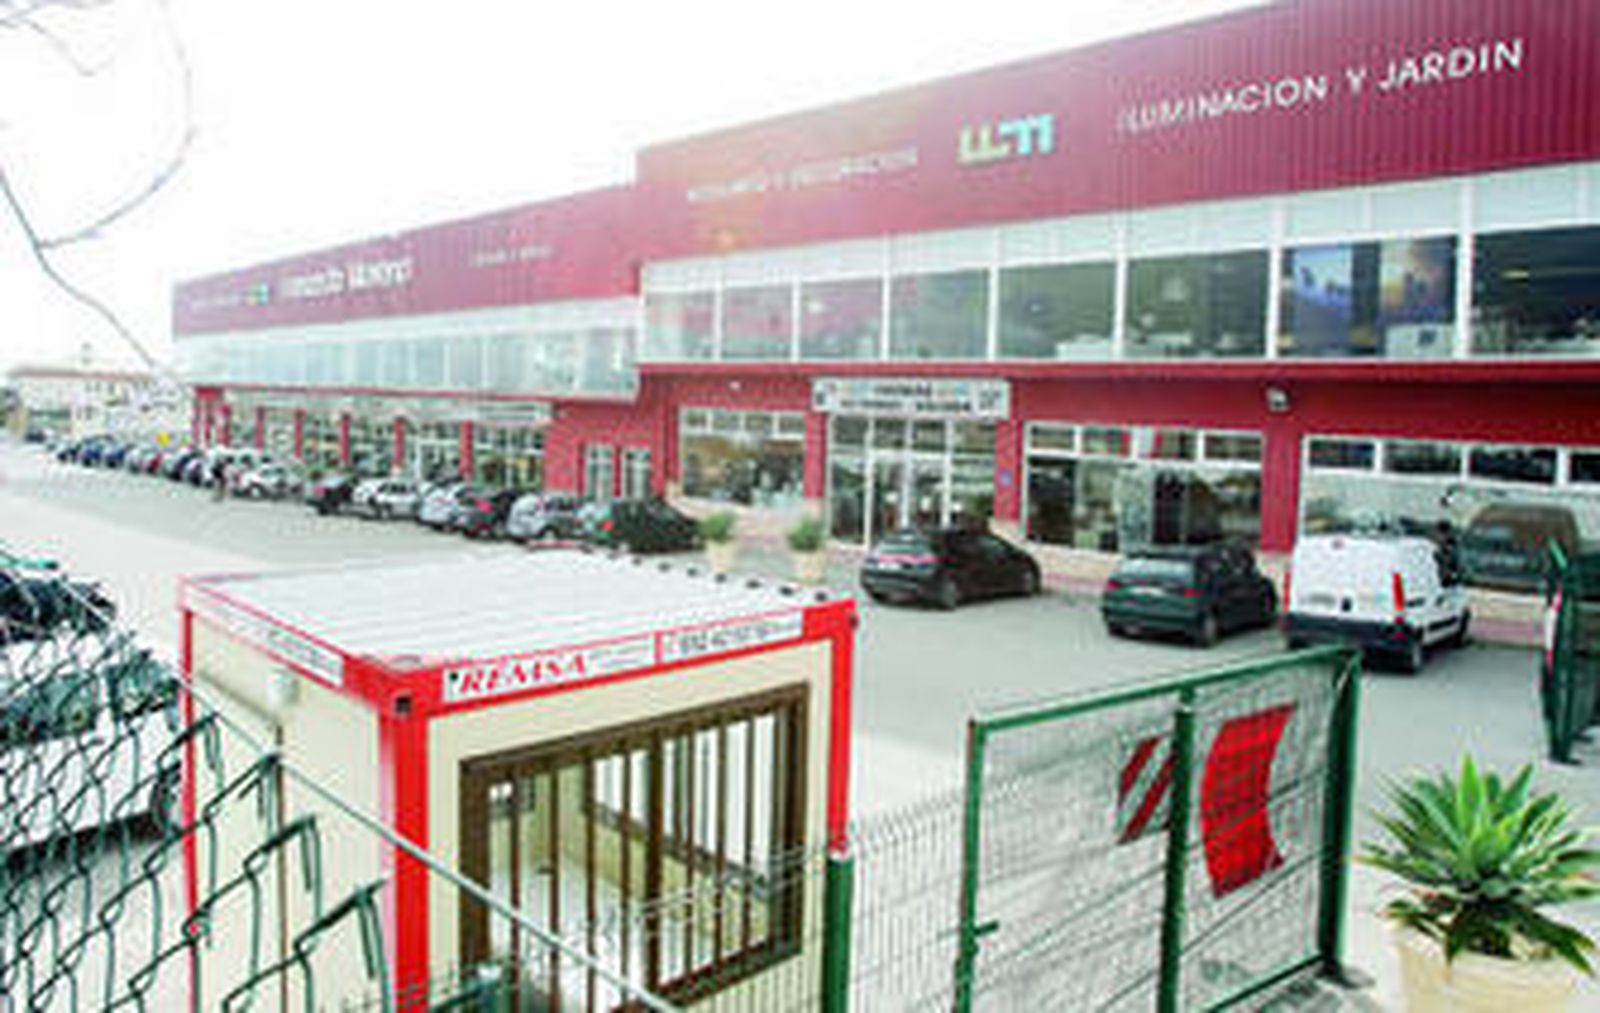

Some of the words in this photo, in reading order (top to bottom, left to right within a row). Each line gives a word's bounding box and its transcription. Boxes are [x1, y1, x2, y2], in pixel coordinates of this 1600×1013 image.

[1116, 75, 1327, 135] ILUMINACION
[1345, 65, 1367, 94] Y
[1378, 38, 1523, 92] JARDIN
